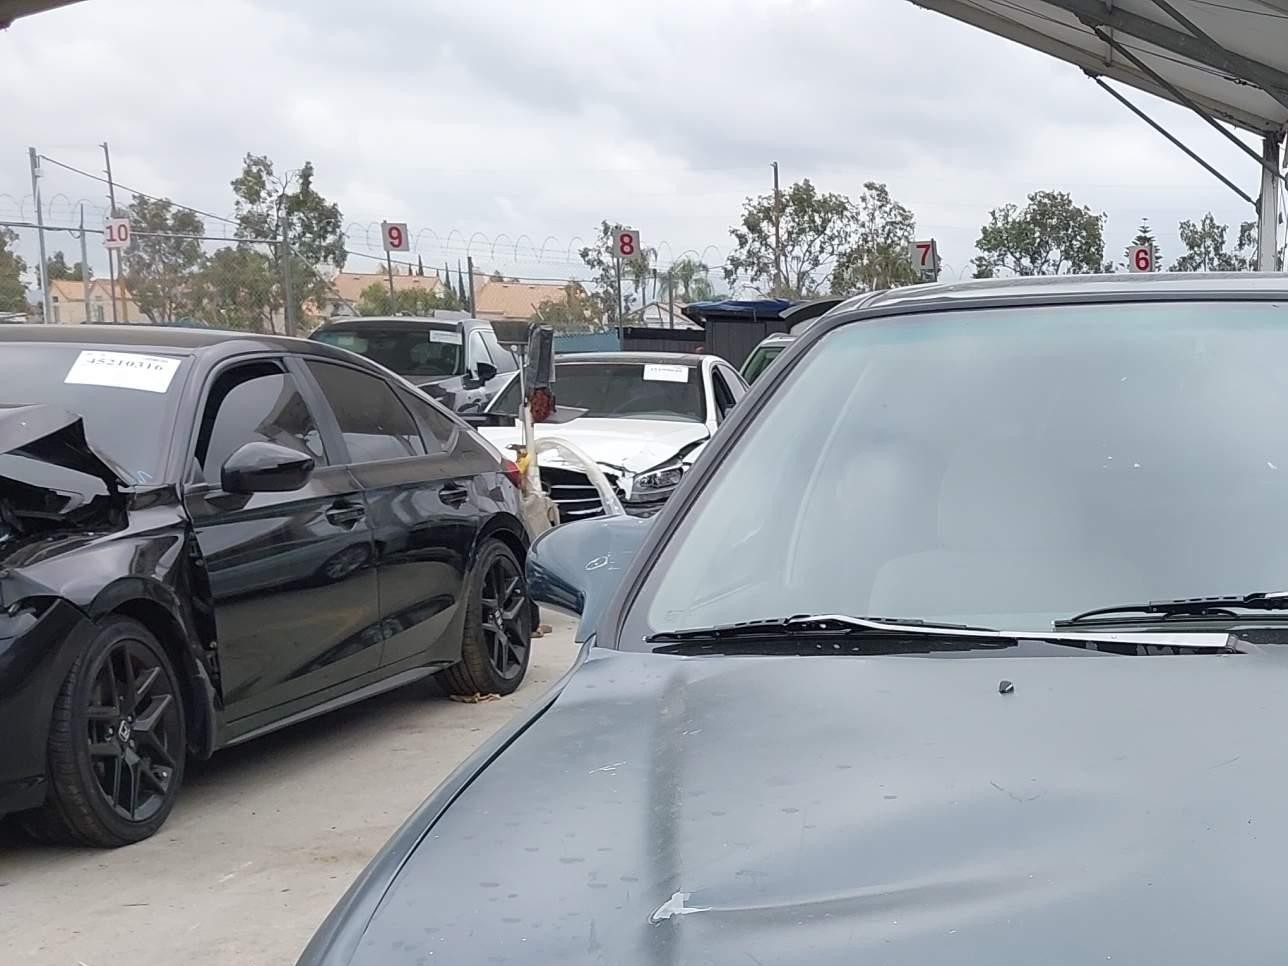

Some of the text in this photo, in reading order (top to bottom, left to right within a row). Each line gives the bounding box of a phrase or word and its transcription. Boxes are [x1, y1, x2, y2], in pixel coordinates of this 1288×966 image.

[105, 224, 128, 242] 10
[387, 226, 403, 248] 9
[620, 234, 634, 255] 8
[916, 244, 931, 266] 7
[1135, 249, 1150, 270] 6
